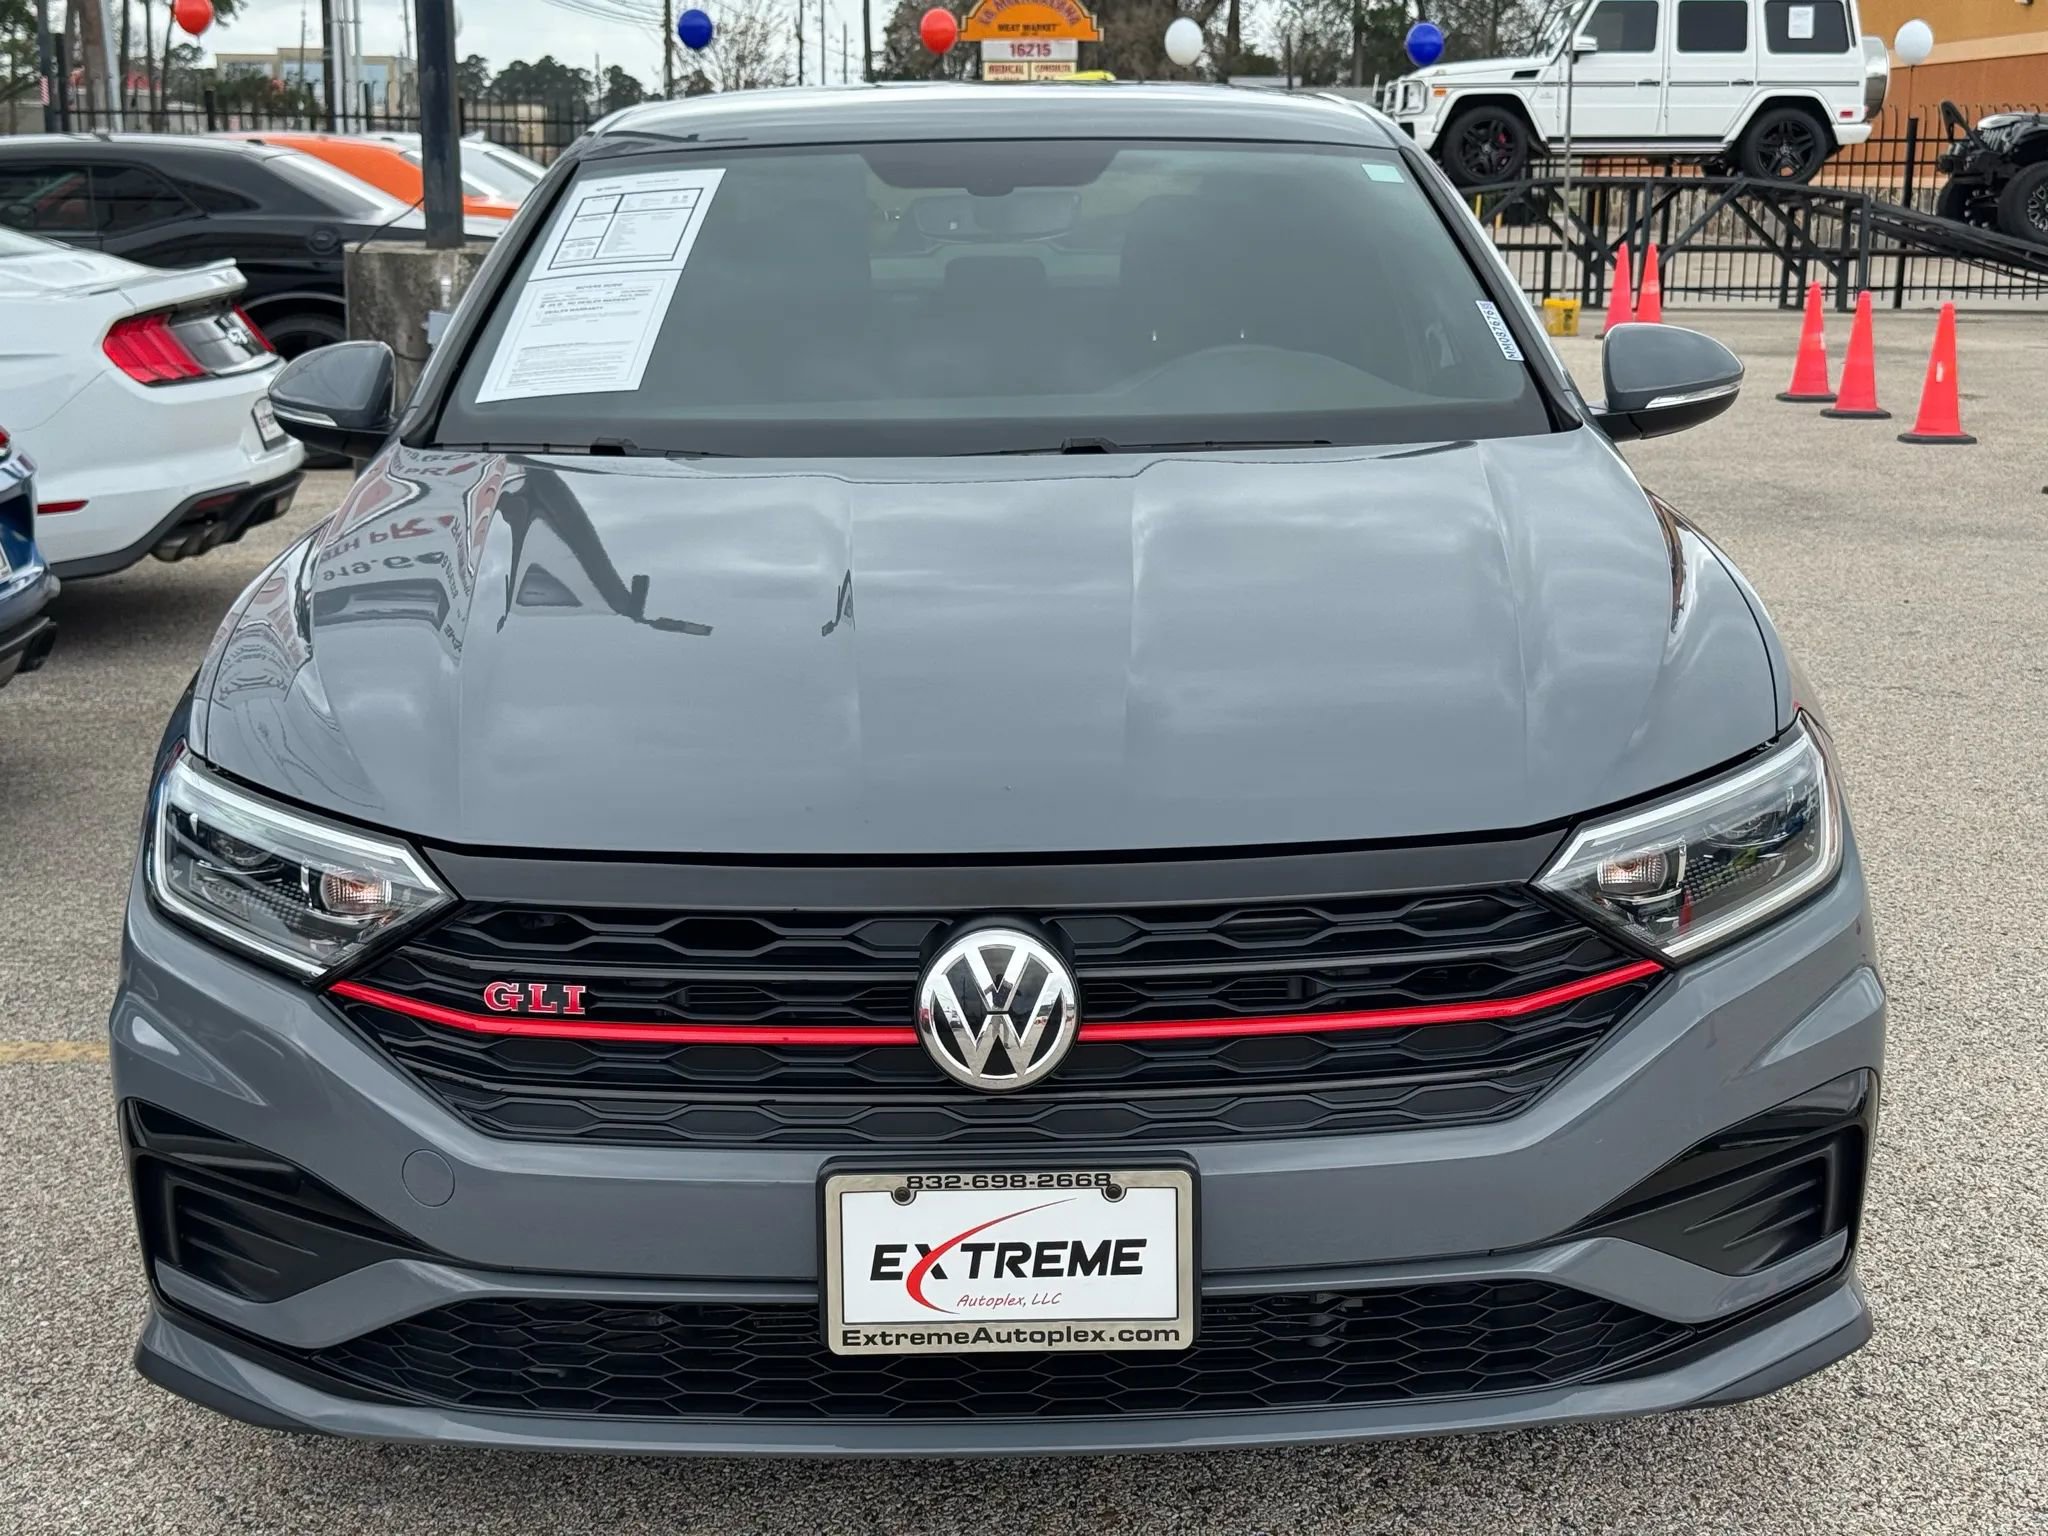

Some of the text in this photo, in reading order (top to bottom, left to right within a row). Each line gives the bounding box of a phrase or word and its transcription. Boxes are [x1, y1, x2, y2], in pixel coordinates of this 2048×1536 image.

[1009, 43, 1052, 57] 16215
[483, 981, 586, 1015] GLI
[906, 1173, 1112, 1190] 832-698-2668
[869, 1238, 1147, 1281] EXTREME
[956, 1292, 1063, 1310] Autoplex, LLC
[842, 1327, 1180, 1347] ExtremeAutoplex.com
